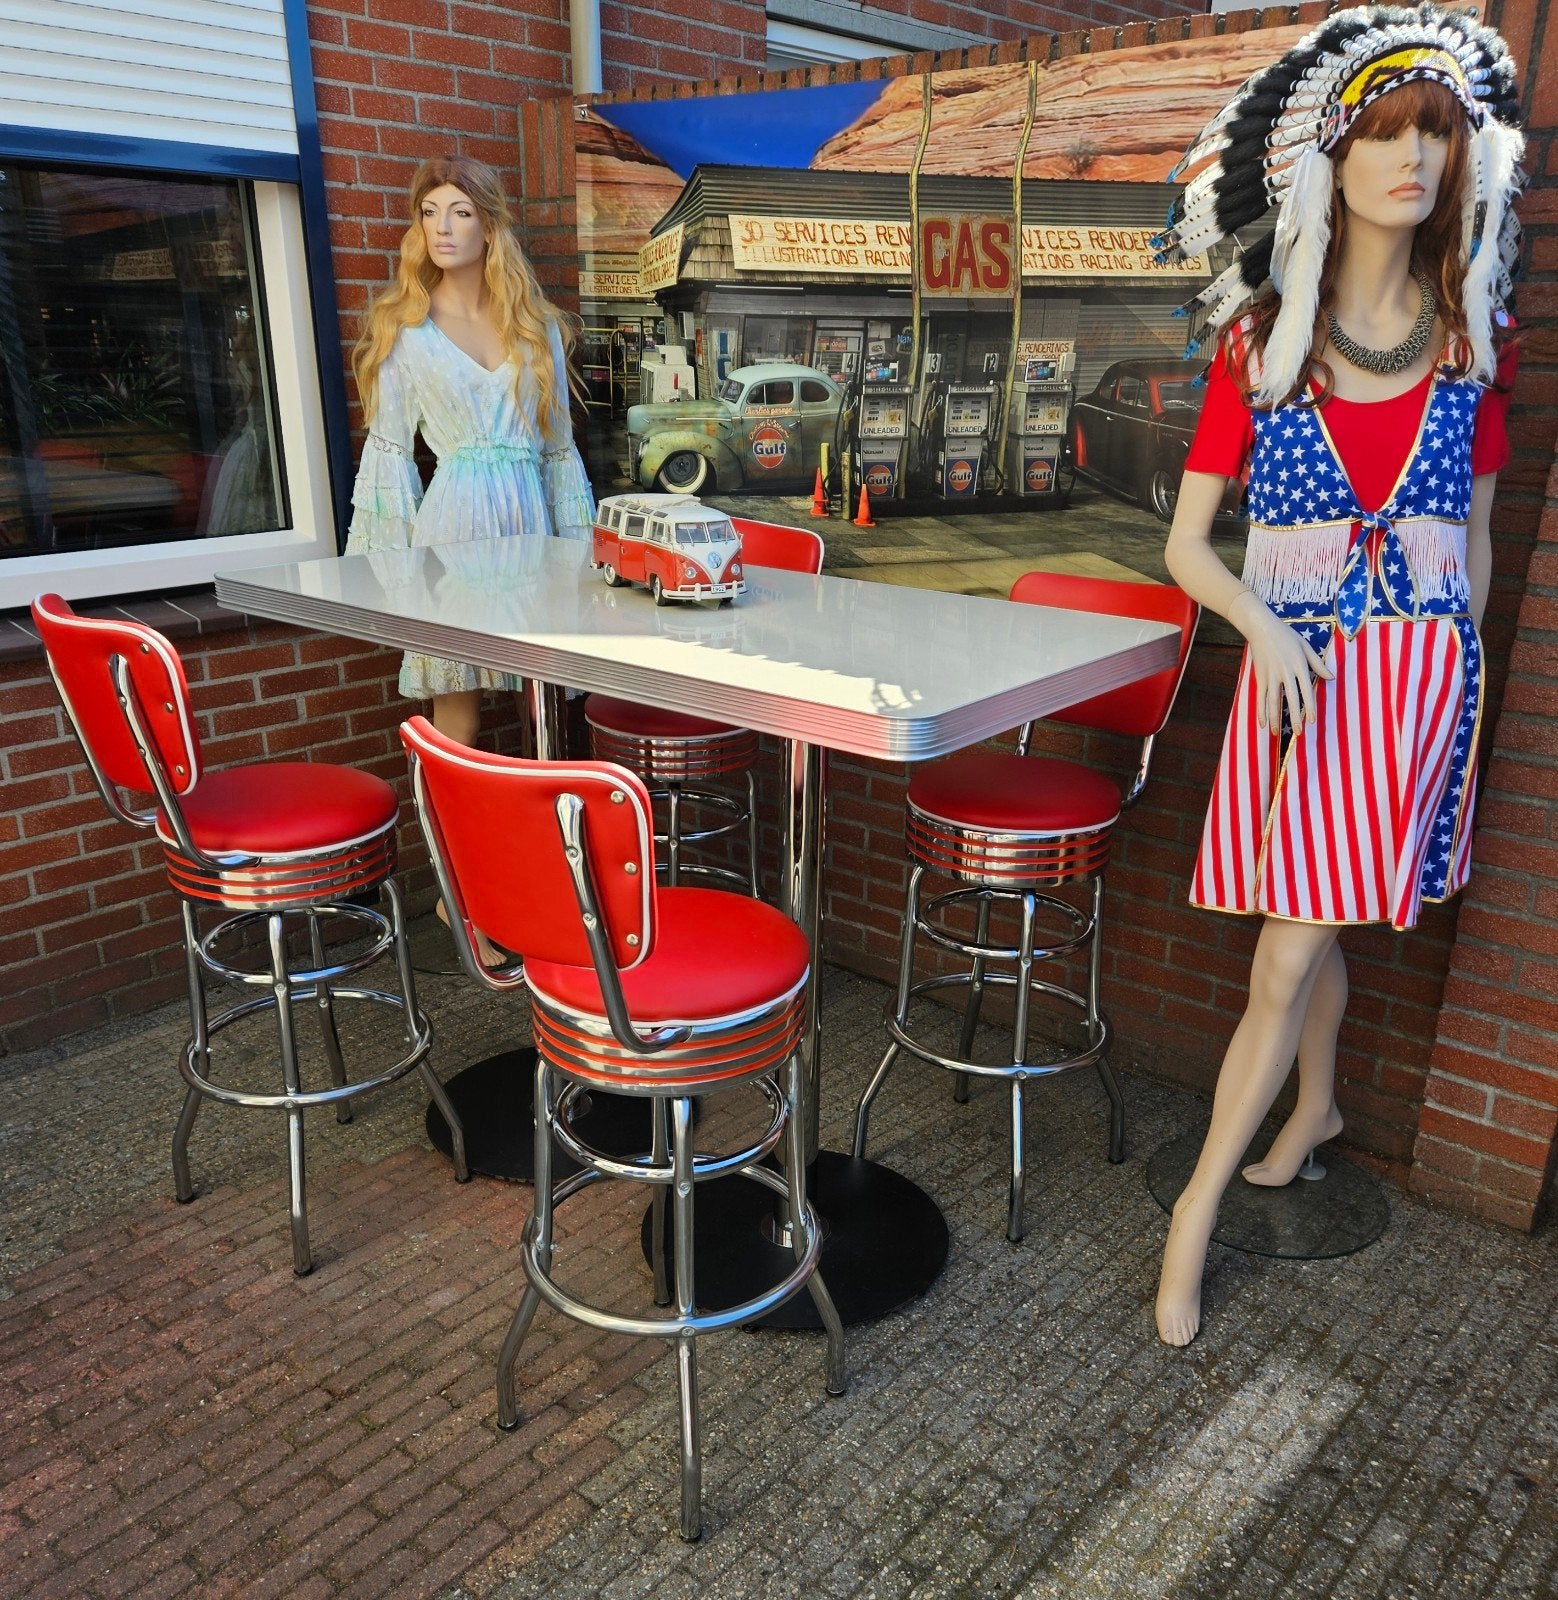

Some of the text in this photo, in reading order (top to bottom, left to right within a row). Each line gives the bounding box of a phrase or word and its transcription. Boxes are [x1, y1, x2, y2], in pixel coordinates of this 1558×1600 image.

[738, 220, 764, 244] 3D
[774, 221, 867, 245] SERVICES
[742, 245, 911, 267] ILLUSTRATIONS RACIN
[923, 219, 1011, 291] GAS
[1080, 254, 1133, 270] RACING
[593, 274, 638, 285] SERVICES
[1025, 343, 1070, 353] RENDERINGS
[846, 353, 854, 372] 4
[931, 353, 938, 372] 3
[989, 353, 997, 372] 2
[863, 426, 900, 434] UNLEADED
[948, 425, 983, 433] UNLEADED
[1025, 424, 1059, 432] UNLEADED
[754, 442, 786, 455] Gulf
[867, 475, 892, 485] Gulf
[949, 471, 972, 481] Gulf
[1027, 471, 1052, 480] Gulf
